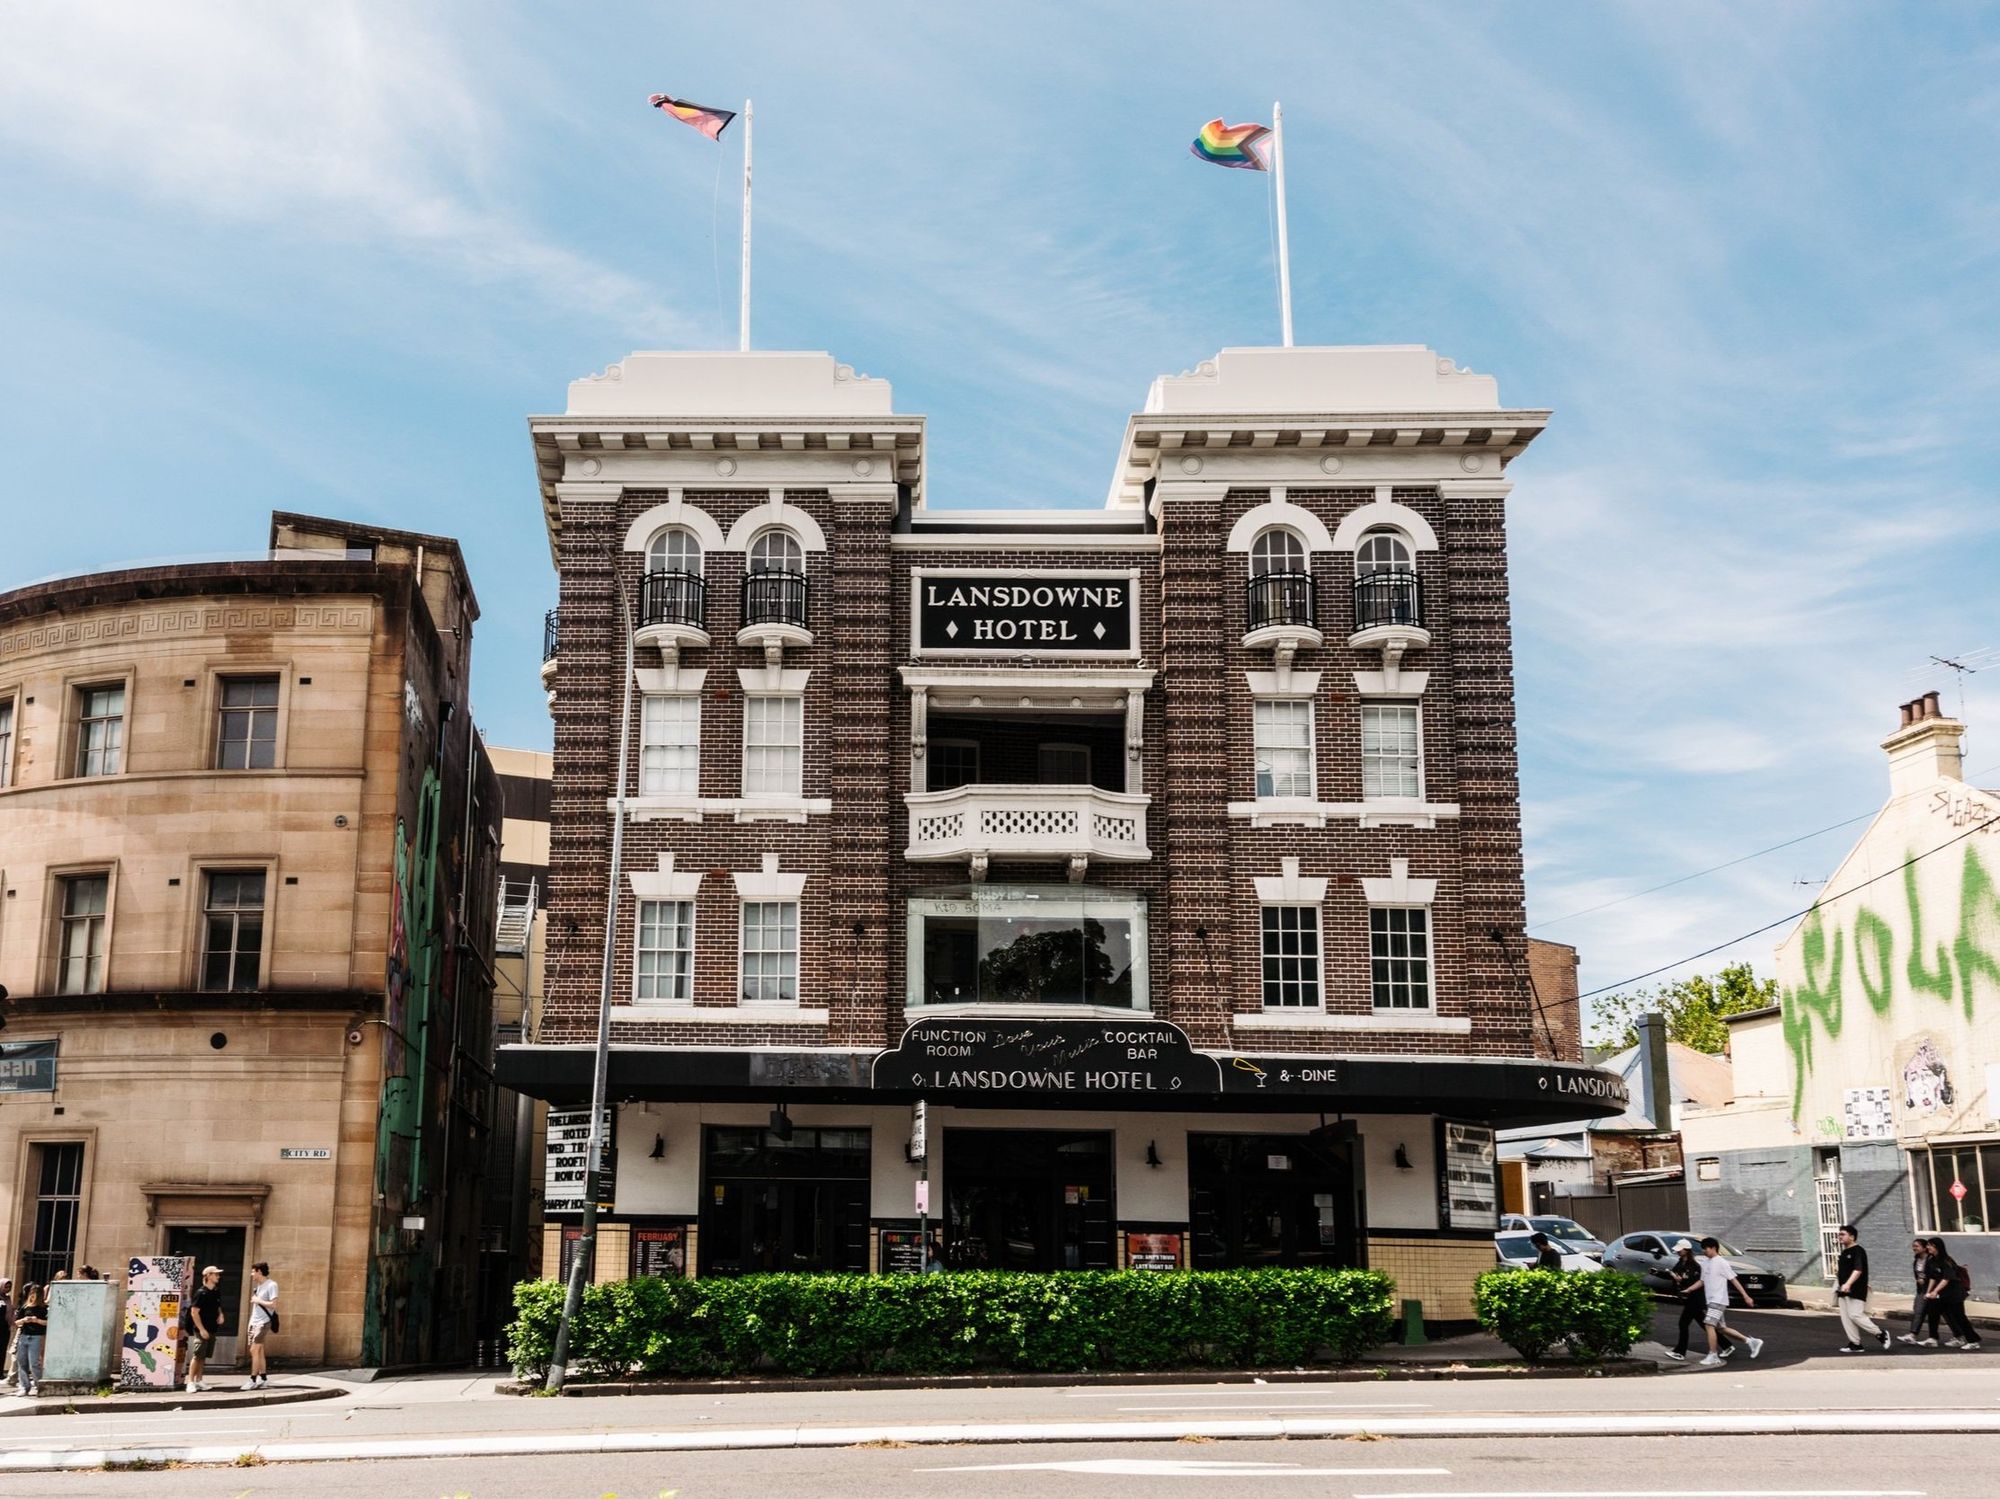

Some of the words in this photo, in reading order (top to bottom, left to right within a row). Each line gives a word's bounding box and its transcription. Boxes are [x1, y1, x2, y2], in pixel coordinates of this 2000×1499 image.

[928, 586, 1124, 608] LANSDOWNE
[973, 619, 1078, 641] HOTEL
[1929, 790, 2000, 834] SLEAZE
[911, 1029, 987, 1043] FUNCTION
[1104, 1031, 1178, 1044] COCKTAIL
[926, 1045, 971, 1057] ROOM
[1127, 1048, 1158, 1059] BAR
[935, 1070, 1076, 1090] LANSDOWNE
[1085, 1071, 1157, 1090] HOTEL
[1301, 1069, 1337, 1082] DINE
[637, 1232, 679, 1241] FEBRUARY
